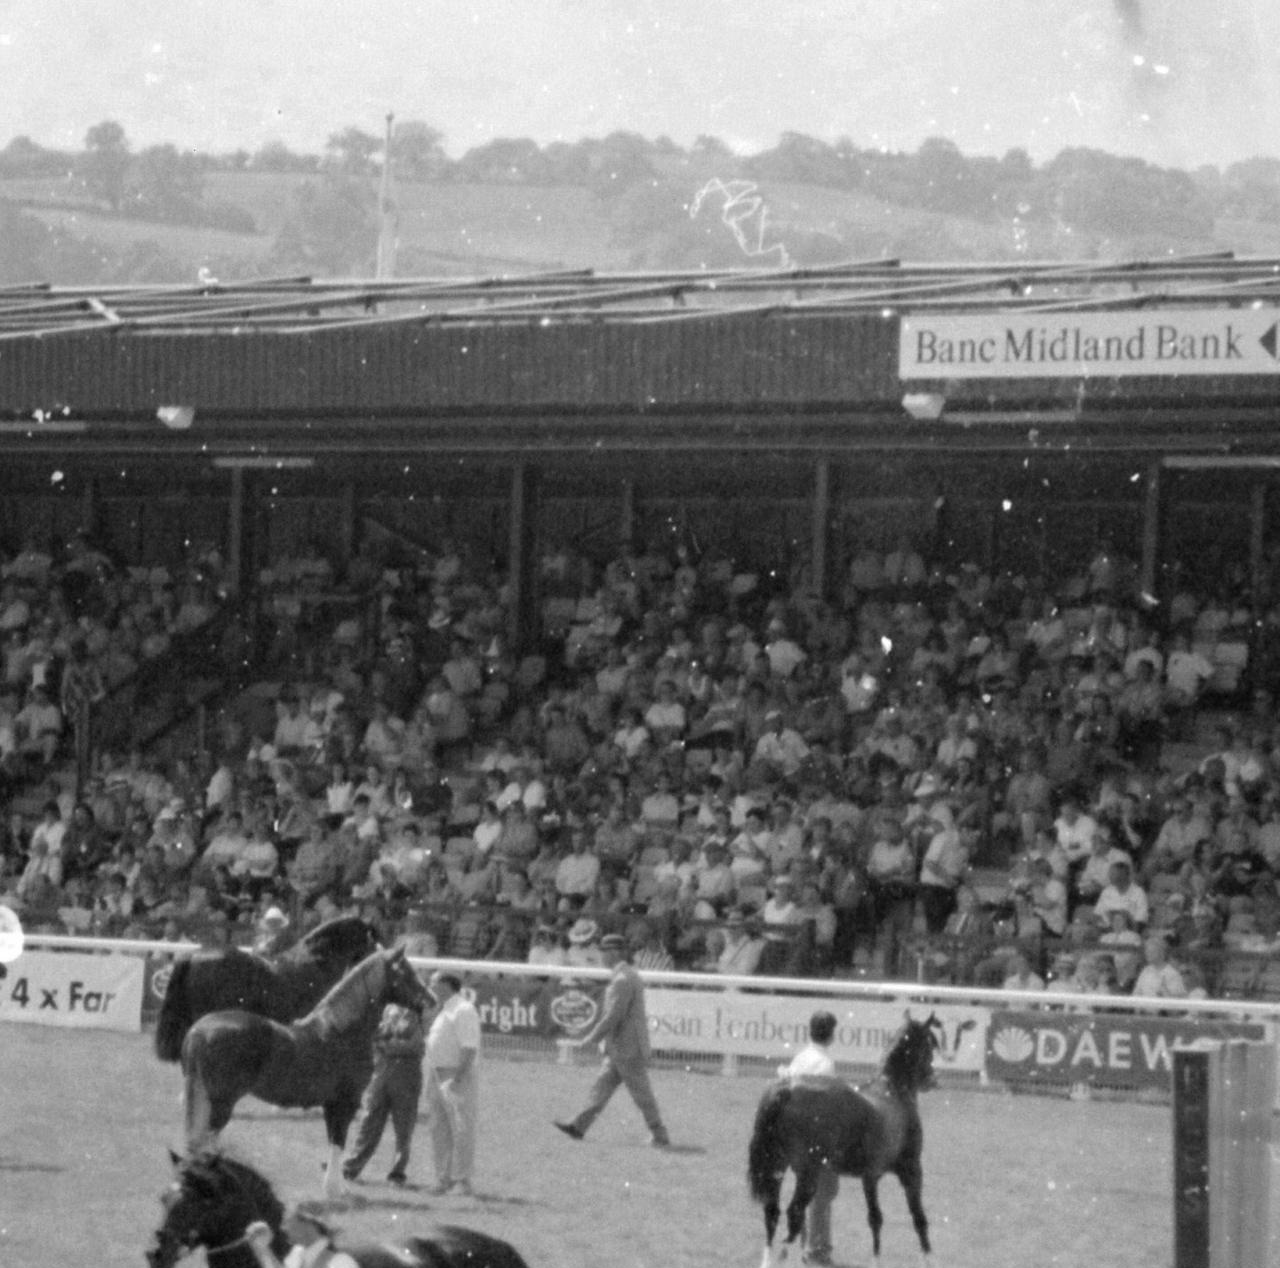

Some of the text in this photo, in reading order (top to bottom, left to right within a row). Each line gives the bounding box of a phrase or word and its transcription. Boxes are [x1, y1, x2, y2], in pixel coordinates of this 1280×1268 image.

[916, 323, 1244, 364] Banc Midland Bank
[10, 977, 30, 1009] 4
[39, 988, 59, 1010] x
[68, 981, 116, 1013] Far
[1037, 1029, 1179, 1070] DAEW
